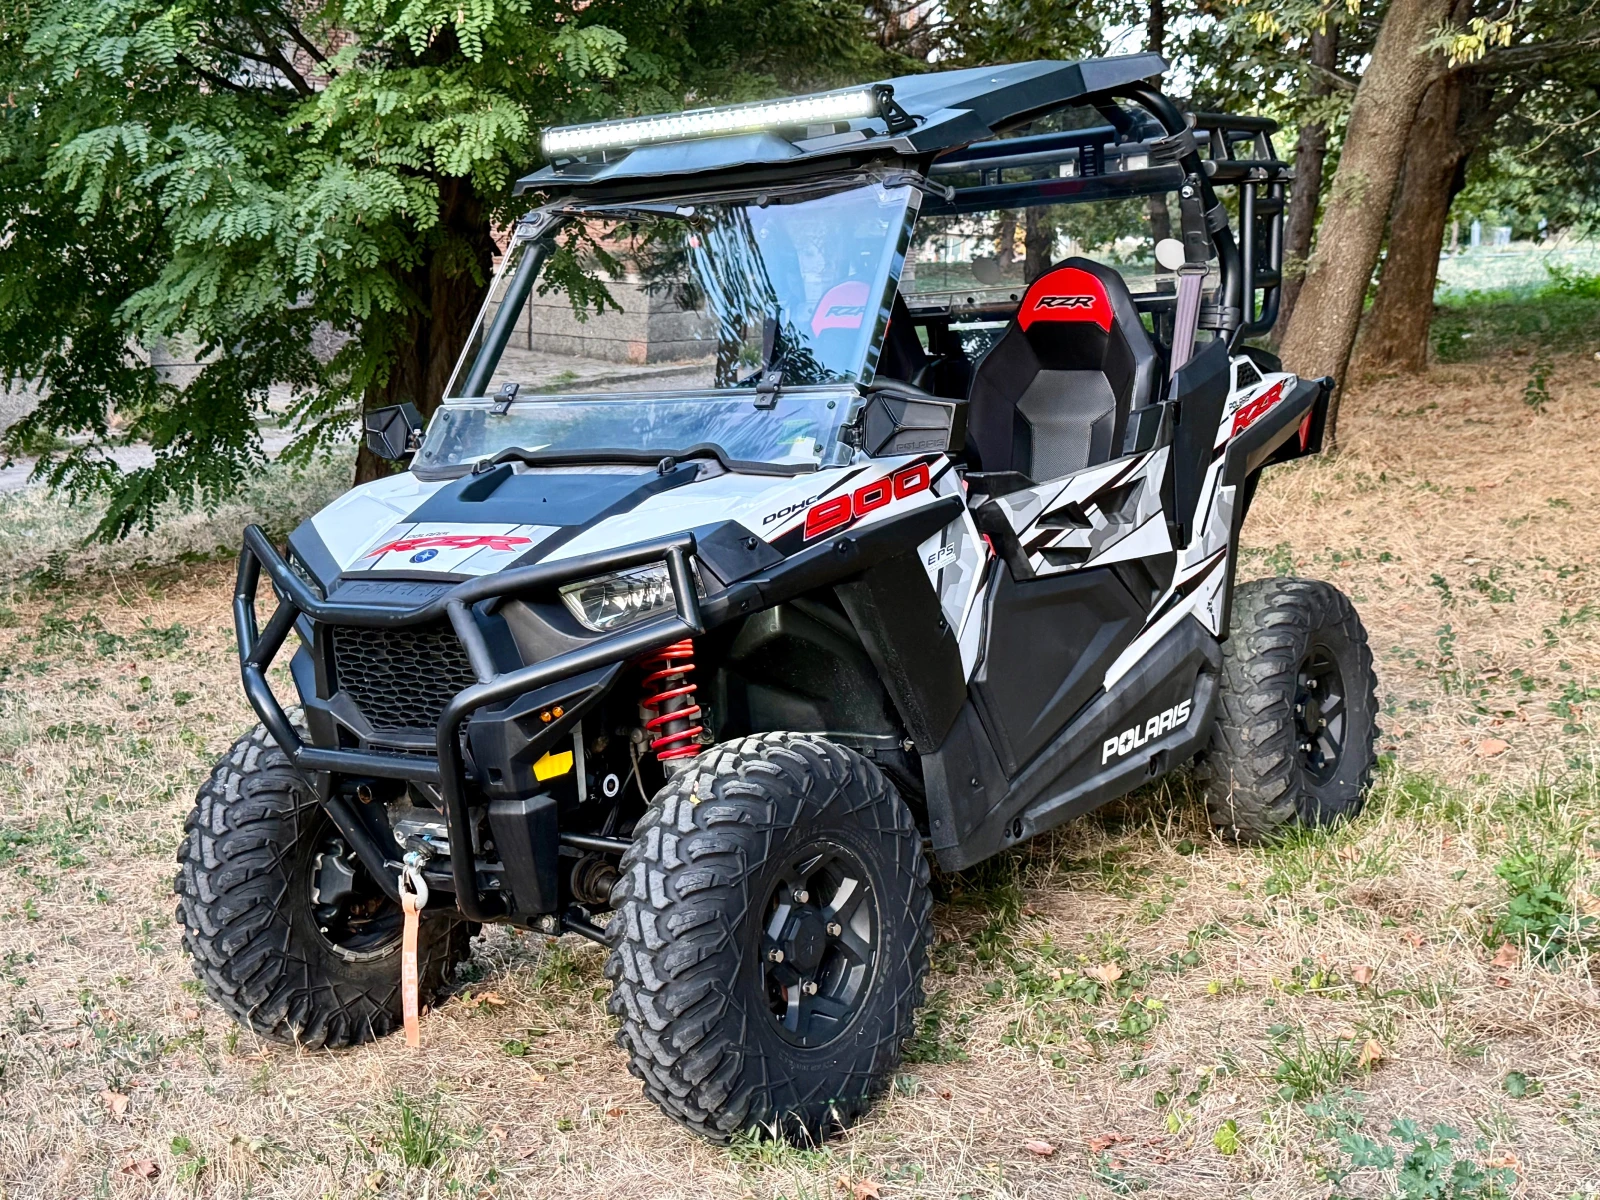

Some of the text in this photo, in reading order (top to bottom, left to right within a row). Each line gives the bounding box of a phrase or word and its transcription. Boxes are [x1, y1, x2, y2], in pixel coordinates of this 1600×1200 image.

[1034, 295, 1096, 310] RZR
[1230, 380, 1284, 438] RZR
[762, 495, 818, 525] DOHC
[804, 462, 930, 541] 900
[362, 535, 533, 560] RZR
[927, 543, 954, 566] EPS
[1102, 698, 1192, 765] POLARIS
